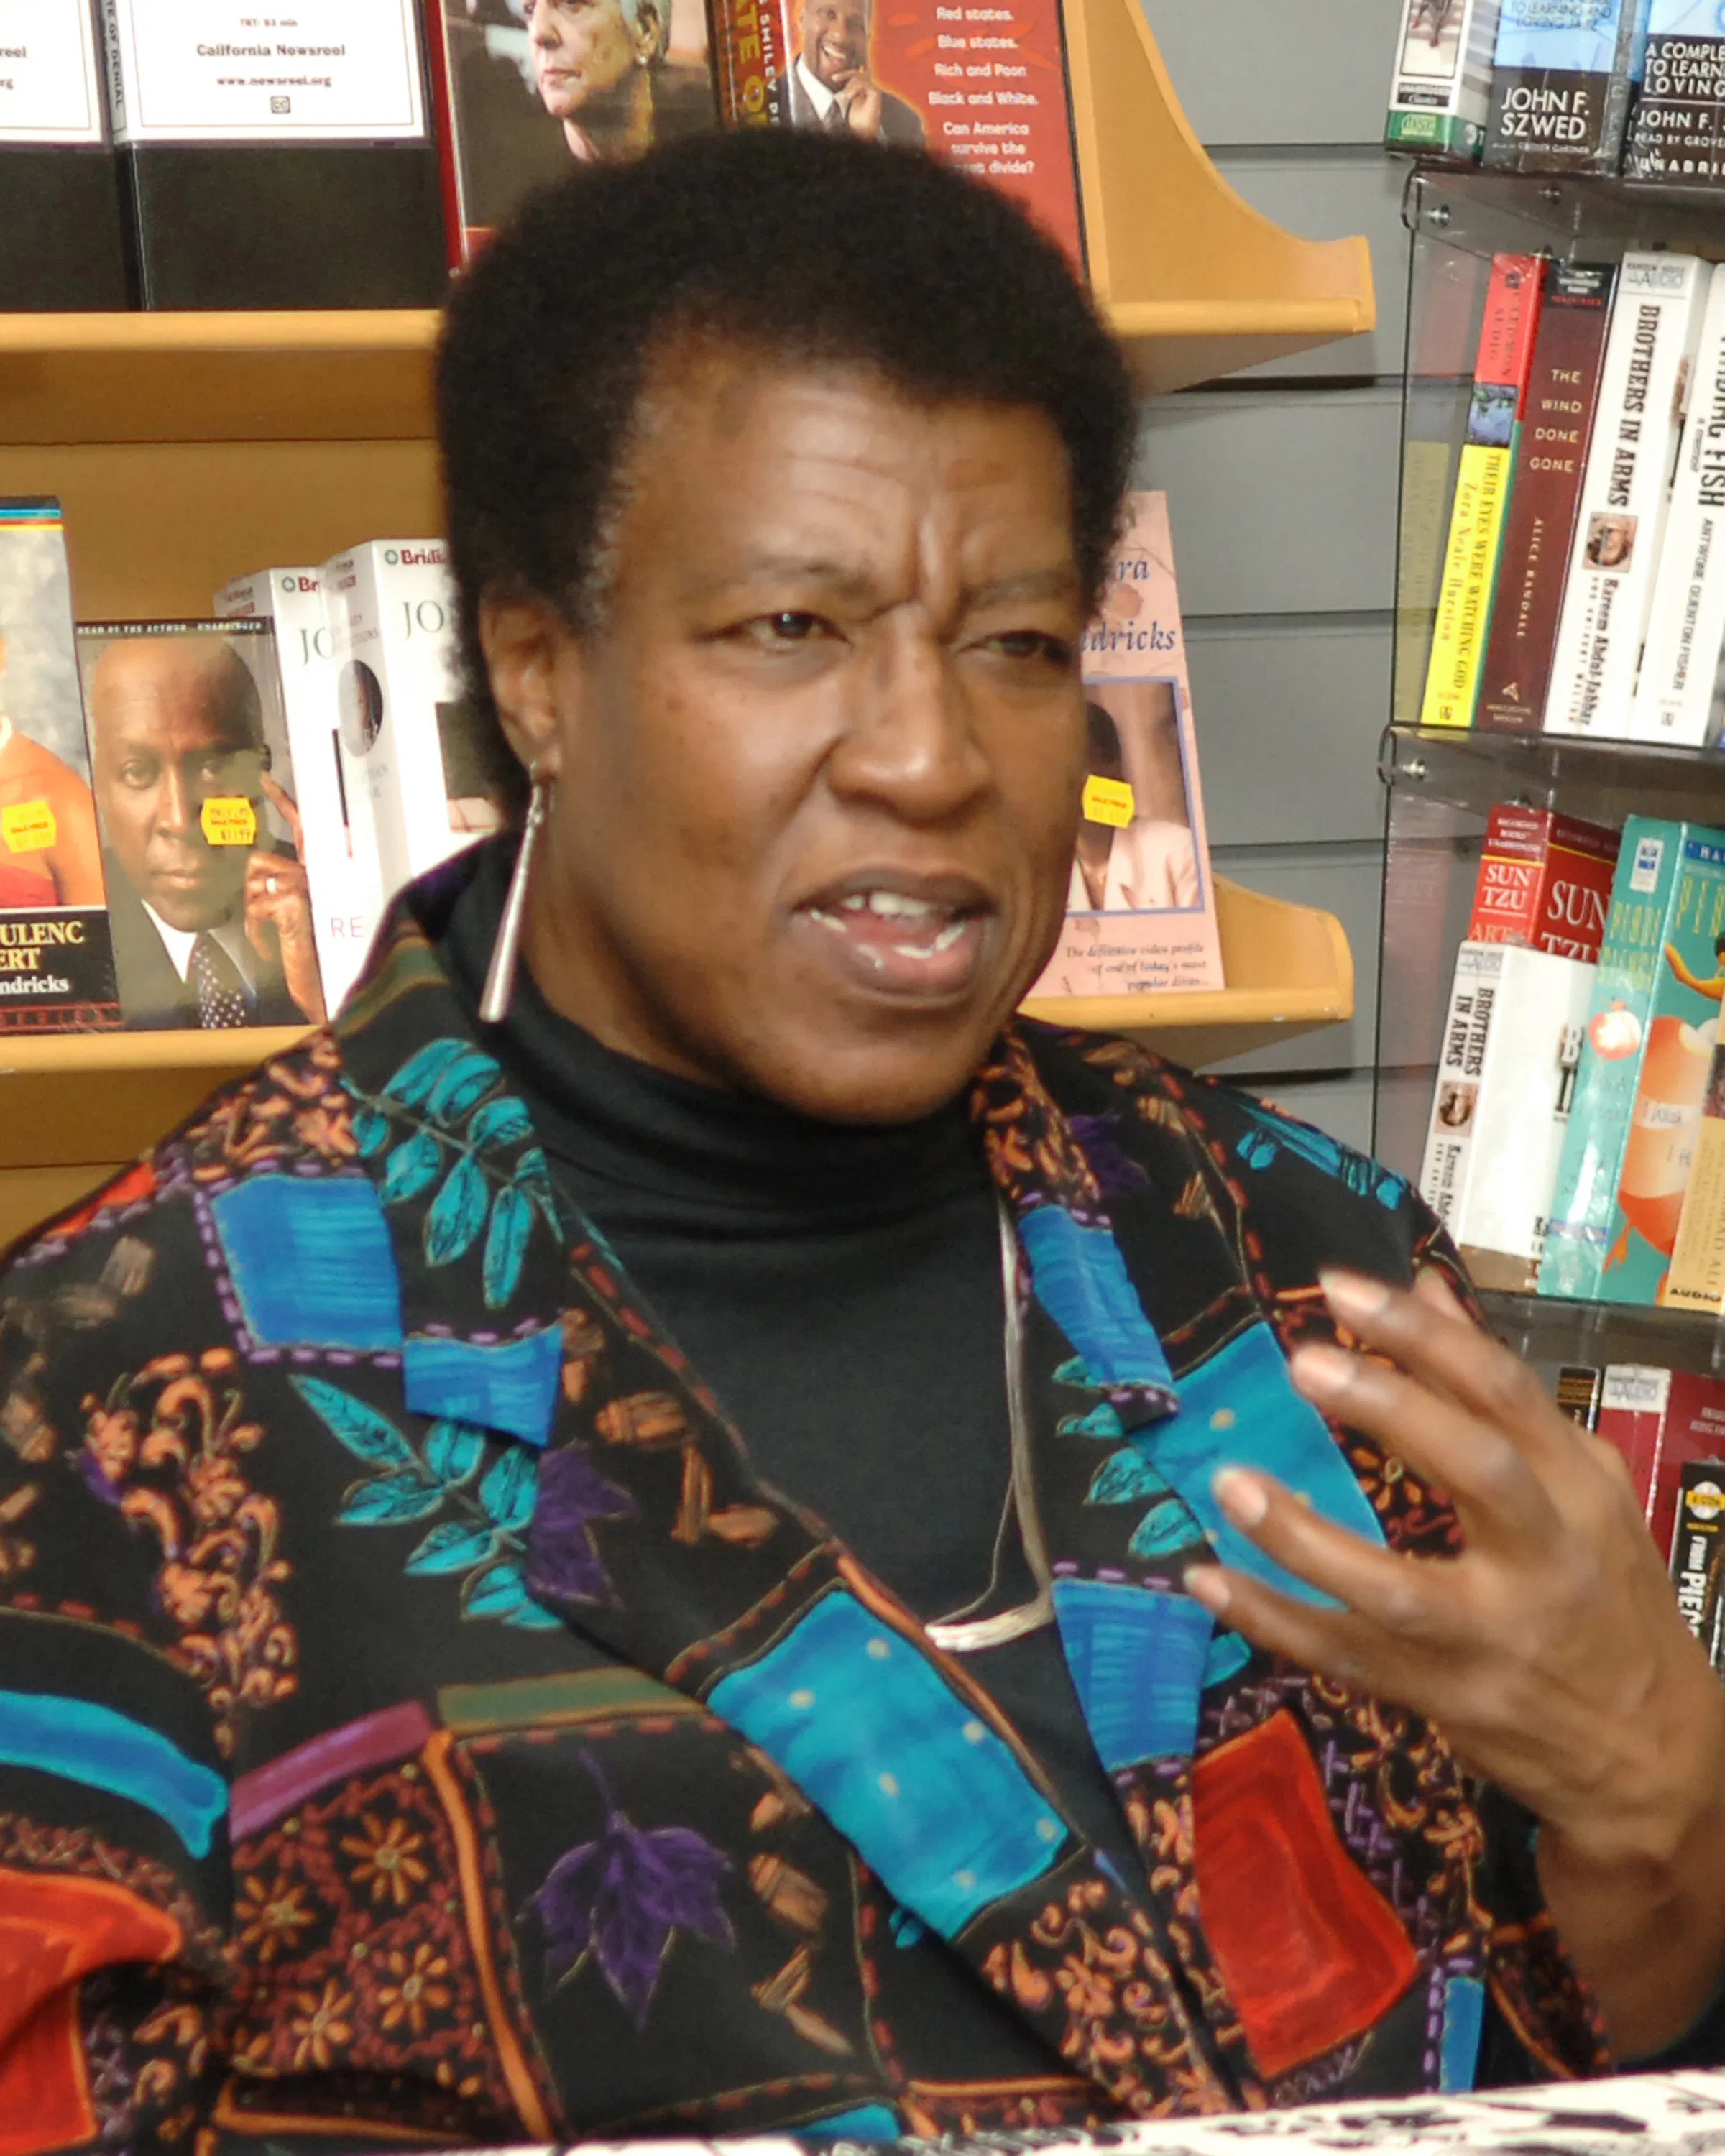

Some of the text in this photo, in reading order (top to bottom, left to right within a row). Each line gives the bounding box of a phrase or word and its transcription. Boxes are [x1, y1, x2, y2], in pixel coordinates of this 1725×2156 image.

[937, 6, 1014, 21] Red states.
[196, 43, 346, 57] California Newsreel
[759, 14, 778, 91] SMILEY
[937, 34, 1019, 49] Blue states.
[1645, 42, 1657, 57] A
[934, 63, 964, 76] Rich
[966, 62, 992, 77] and
[1645, 57, 1725, 78] TO LEARN
[111, 50, 123, 109] DENIAL
[217, 75, 332, 88] www.newsreel.org
[928, 91, 1039, 106] Black and White.
[1501, 86, 1591, 116] JOHN F.
[942, 121, 1031, 135] Can America
[1501, 111, 1588, 140] SZWED
[1637, 109, 1714, 132] JOHN F.
[951, 141, 1026, 155] survive the
[1634, 132, 1665, 144] READ
[1666, 134, 1680, 145] BY
[989, 160, 1035, 173] divide?
[1623, 303, 1661, 414] BROTHERS
[1551, 369, 1582, 384] THE
[1541, 399, 1583, 413] WIND
[1535, 427, 1580, 443] DONE
[1618, 418, 1642, 443] IN
[1529, 456, 1575, 473] GONE
[1606, 446, 1637, 508] ARMS
[1459, 482, 1479, 517] Zora
[400, 548, 448, 566] Brilli
[1453, 453, 1502, 689] THEIR EYES WERE WATCHING GOD
[1516, 517, 1545, 640] ALICE RANDALL
[402, 600, 445, 640] JO
[1441, 577, 1465, 641] Hurston
[1578, 578, 1619, 726] Kareem Abdul-Jabbar
[1700, 844, 1725, 863] HA
[1485, 864, 1531, 888] SUN
[1483, 885, 1528, 910] TZU
[1547, 880, 1607, 930] SUN
[1446, 995, 1473, 1067] IN ARMS
[1464, 987, 1494, 1077] BROTHERS
[1670, 1286, 1721, 1303] AUDIO
